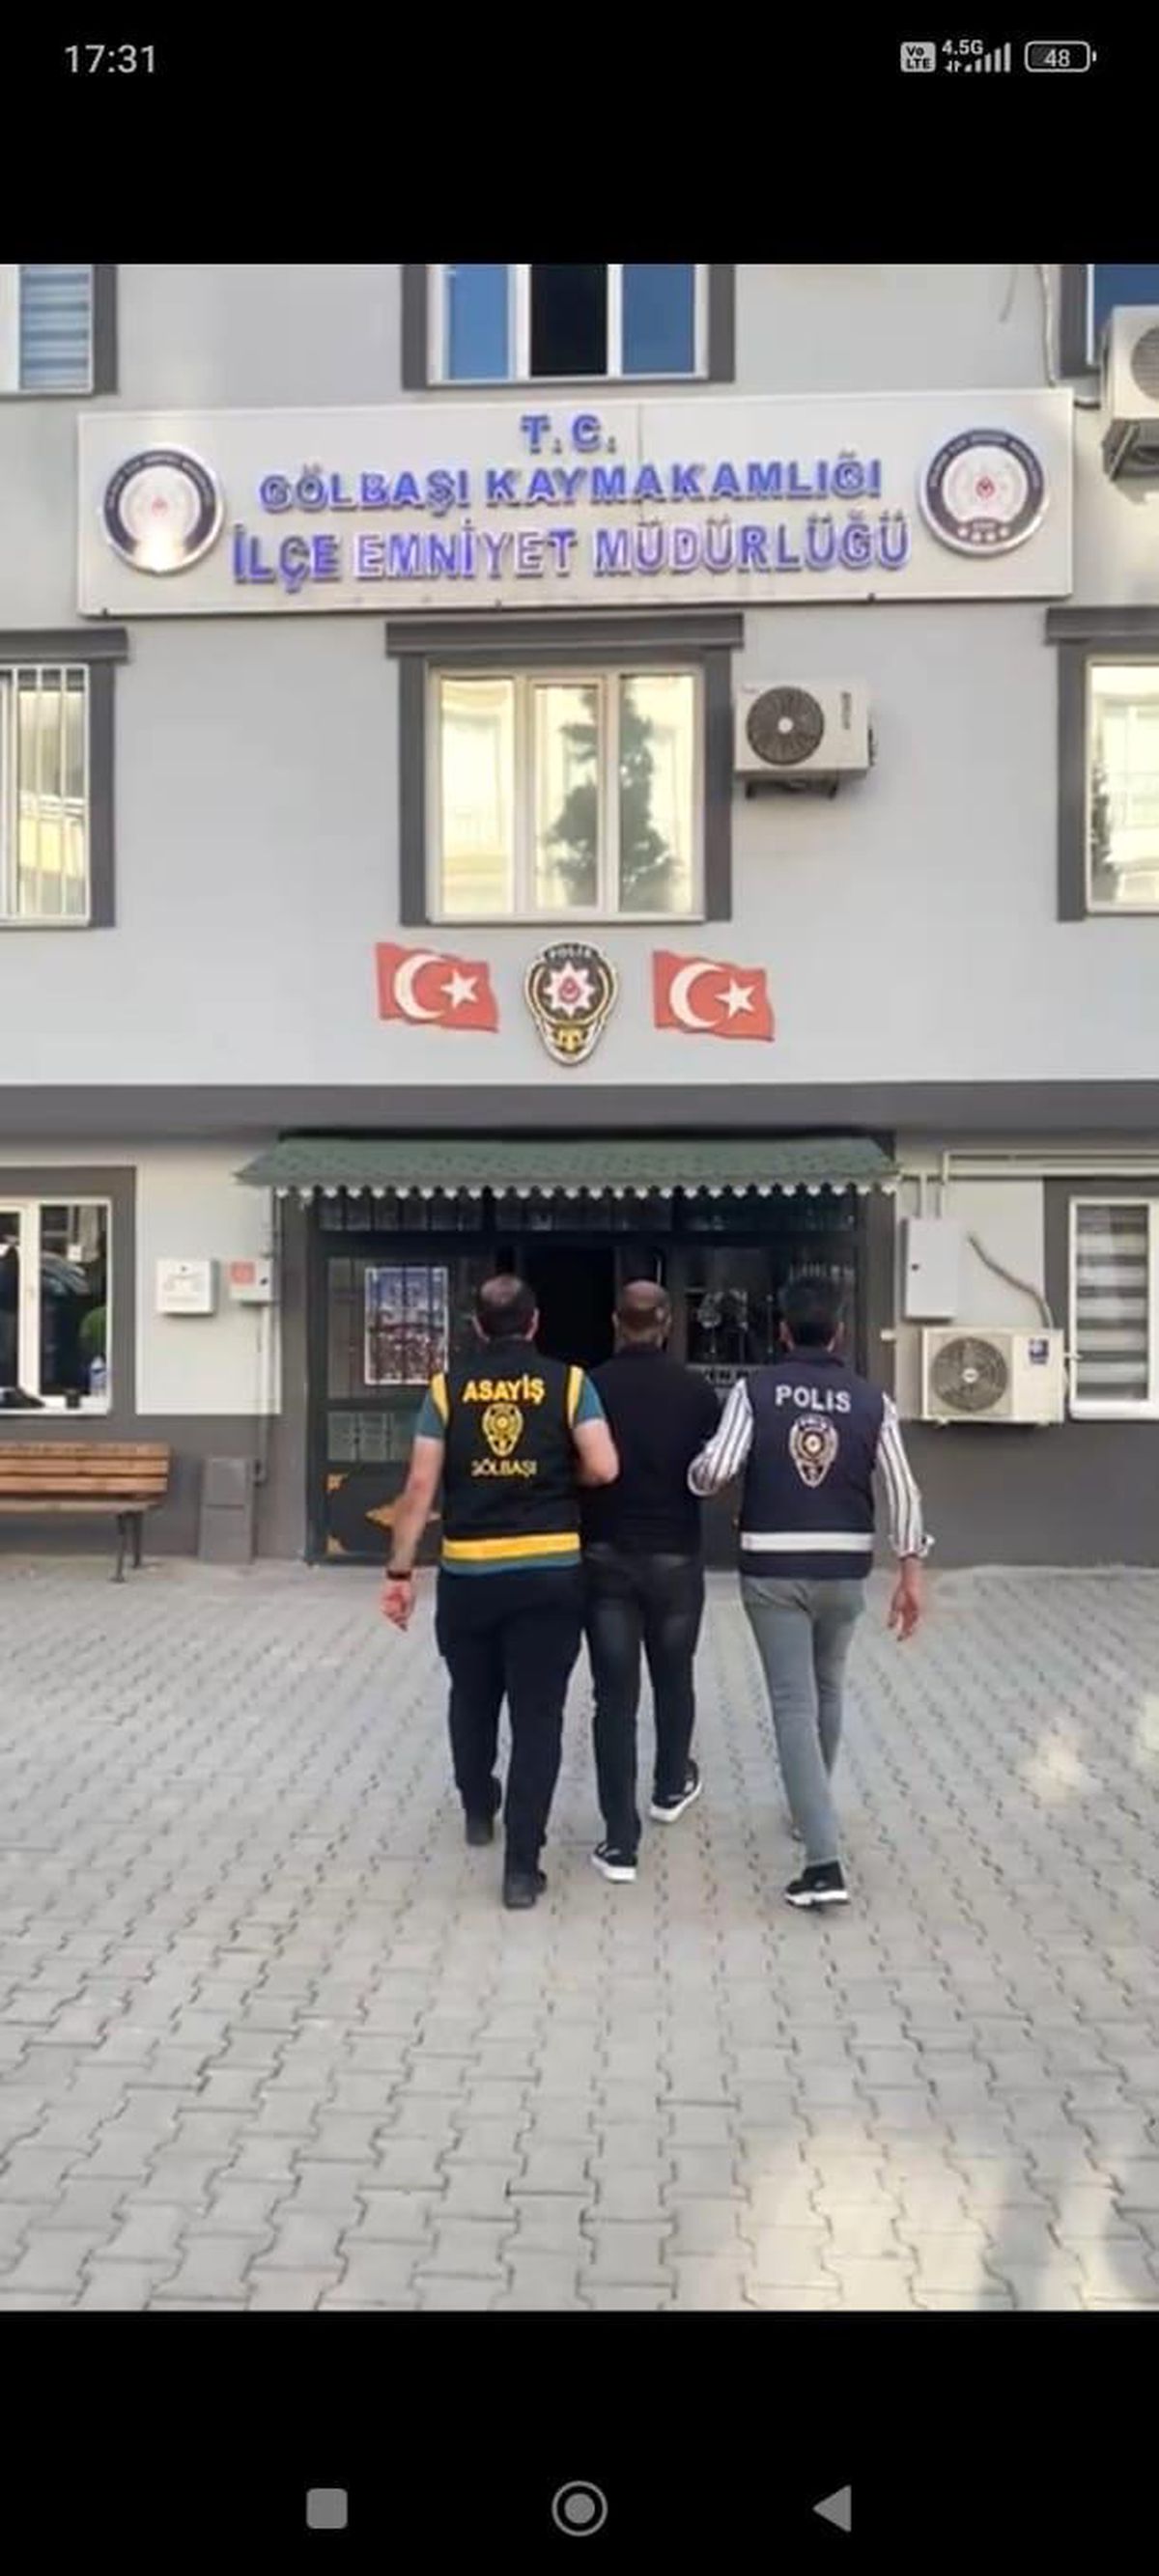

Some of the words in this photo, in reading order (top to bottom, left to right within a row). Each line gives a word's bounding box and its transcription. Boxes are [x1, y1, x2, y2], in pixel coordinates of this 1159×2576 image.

[259, 463, 470, 517] GÖLBAŞI
[485, 451, 883, 507] KAYMAKAMLIĞI
[233, 523, 341, 591] İLÇE
[353, 518, 579, 580] EMNİYET
[593, 510, 911, 577] MÜDÜRLÜĞÜ
[462, 1373, 547, 1406] ASAYİŞ
